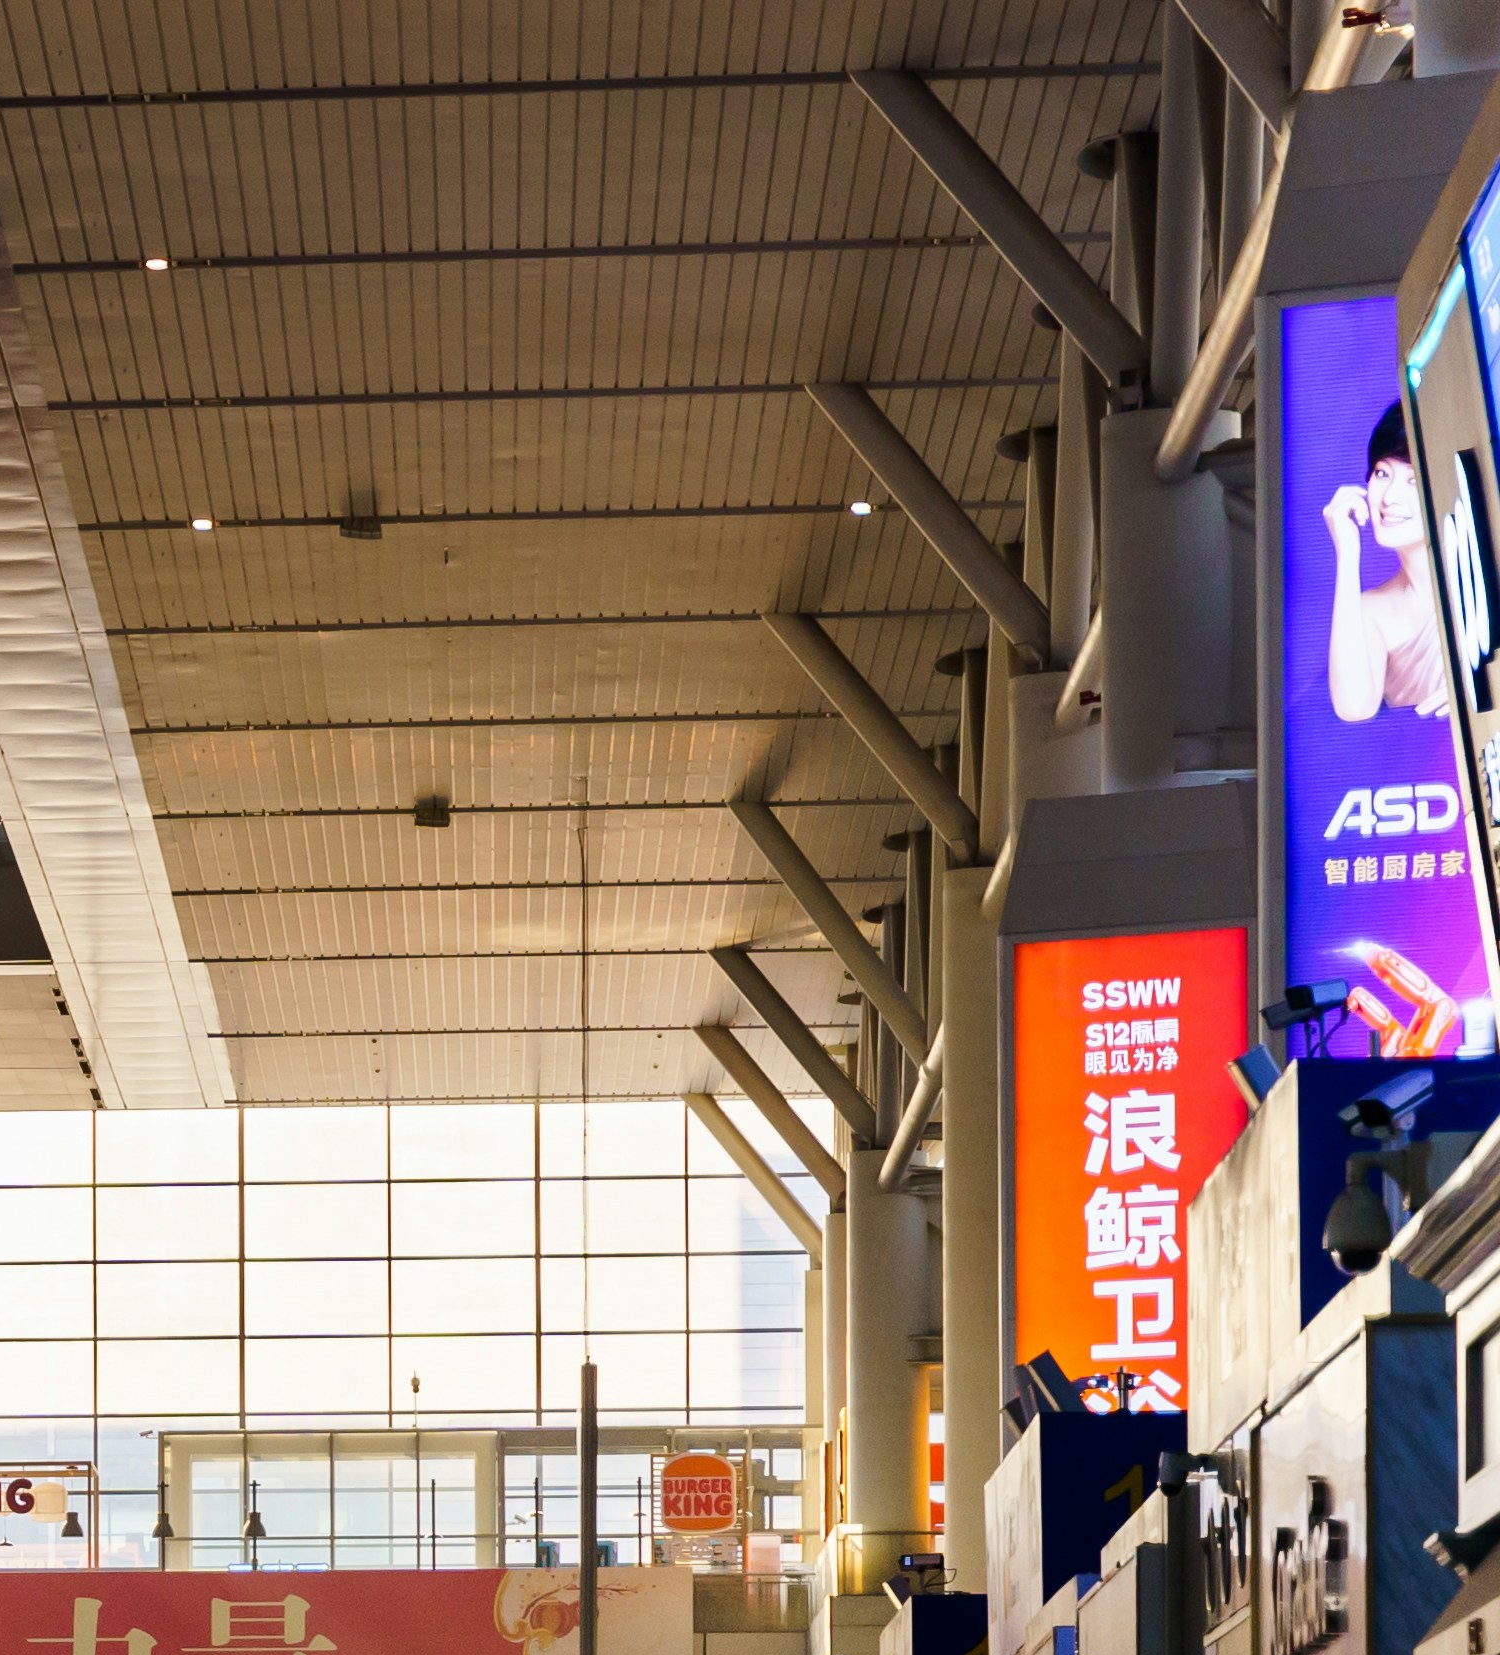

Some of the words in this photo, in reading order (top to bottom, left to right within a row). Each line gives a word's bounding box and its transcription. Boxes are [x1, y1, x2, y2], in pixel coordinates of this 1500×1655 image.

[1324, 784, 1461, 839] ASD
[1082, 977, 1181, 1009] SSWW
[1085, 1018, 1179, 1047] S12脉霸
[1084, 1046, 1179, 1074] 眼见为净
[664, 1479, 733, 1494] BURGER
[664, 1494, 733, 1517] KING
